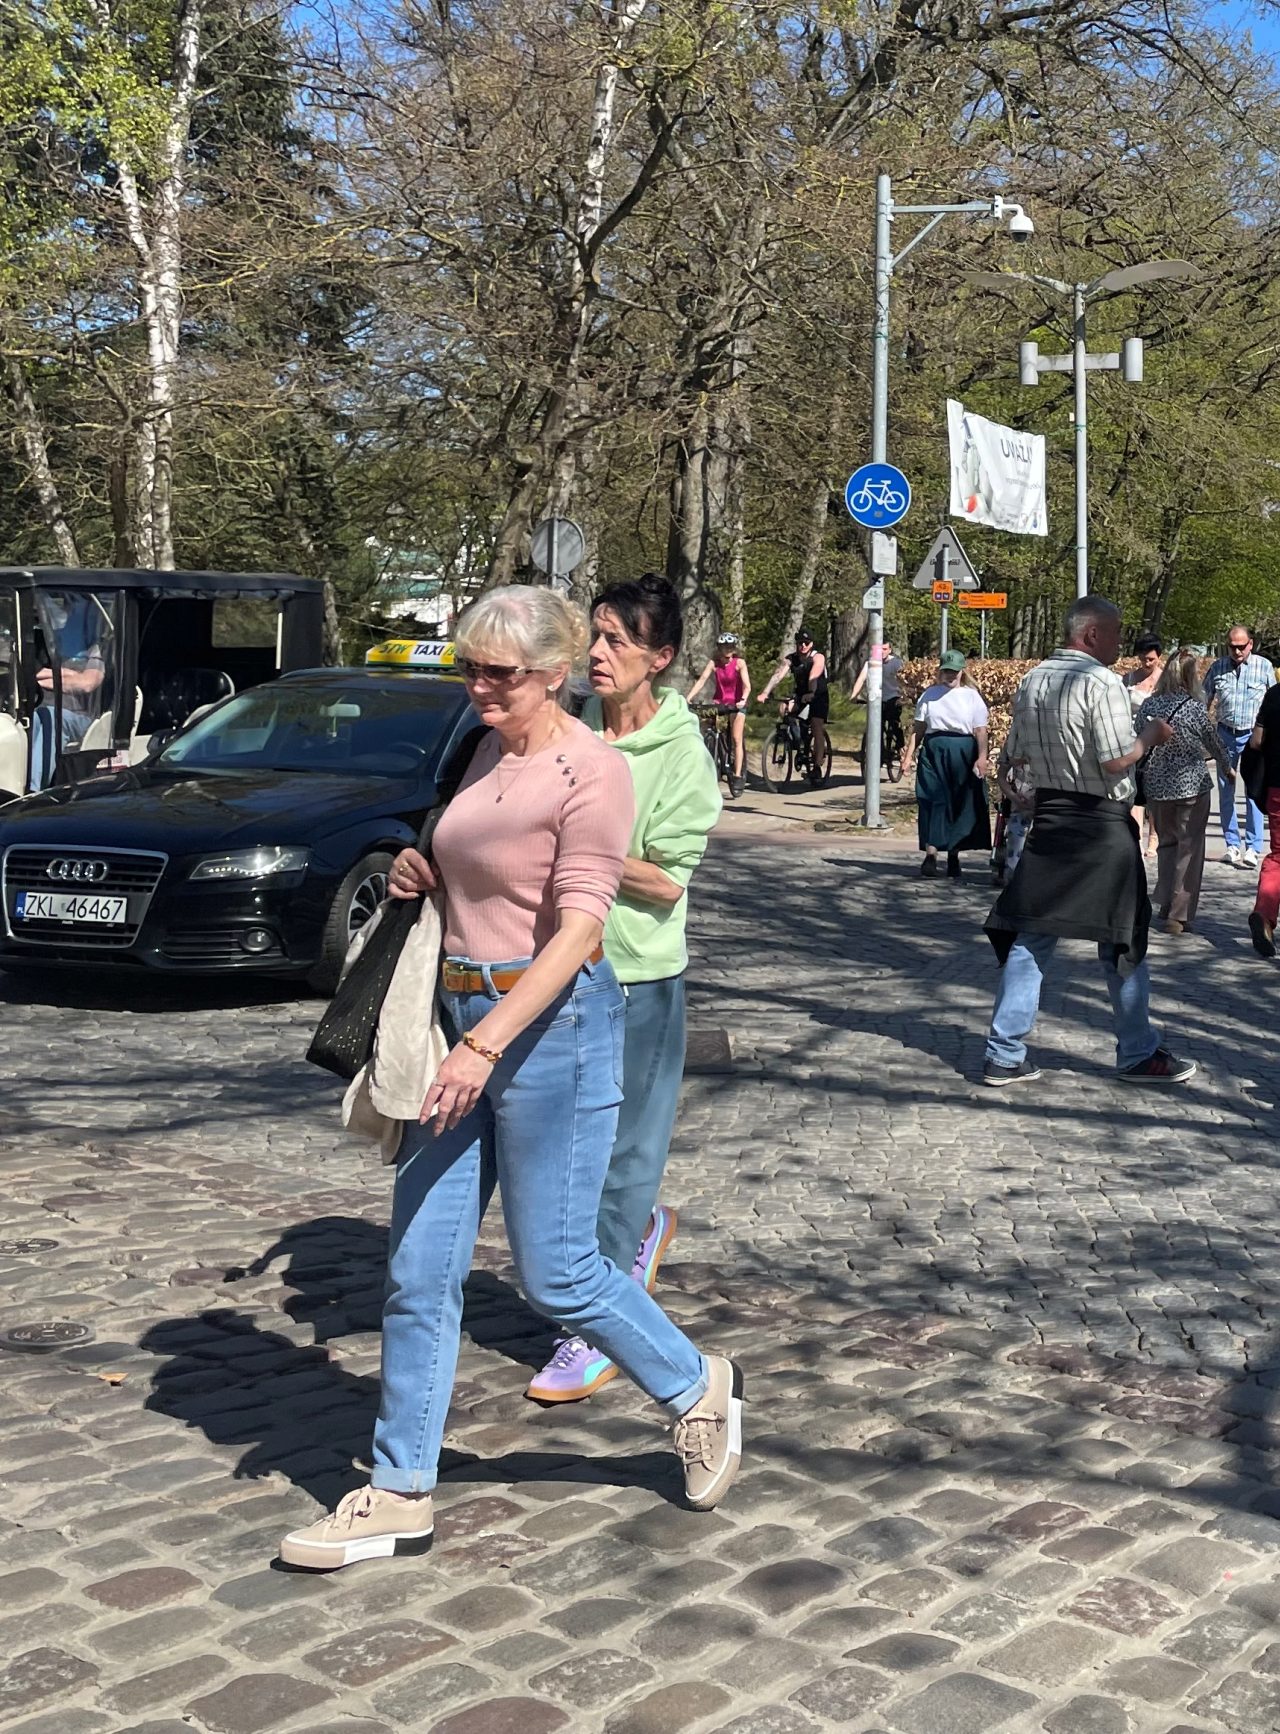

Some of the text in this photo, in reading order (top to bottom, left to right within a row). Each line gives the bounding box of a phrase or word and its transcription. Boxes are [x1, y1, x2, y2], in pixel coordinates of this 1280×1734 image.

[414, 644, 446, 656] TAXI
[25, 895, 58, 917] ZKL
[66, 897, 124, 921] 46467
